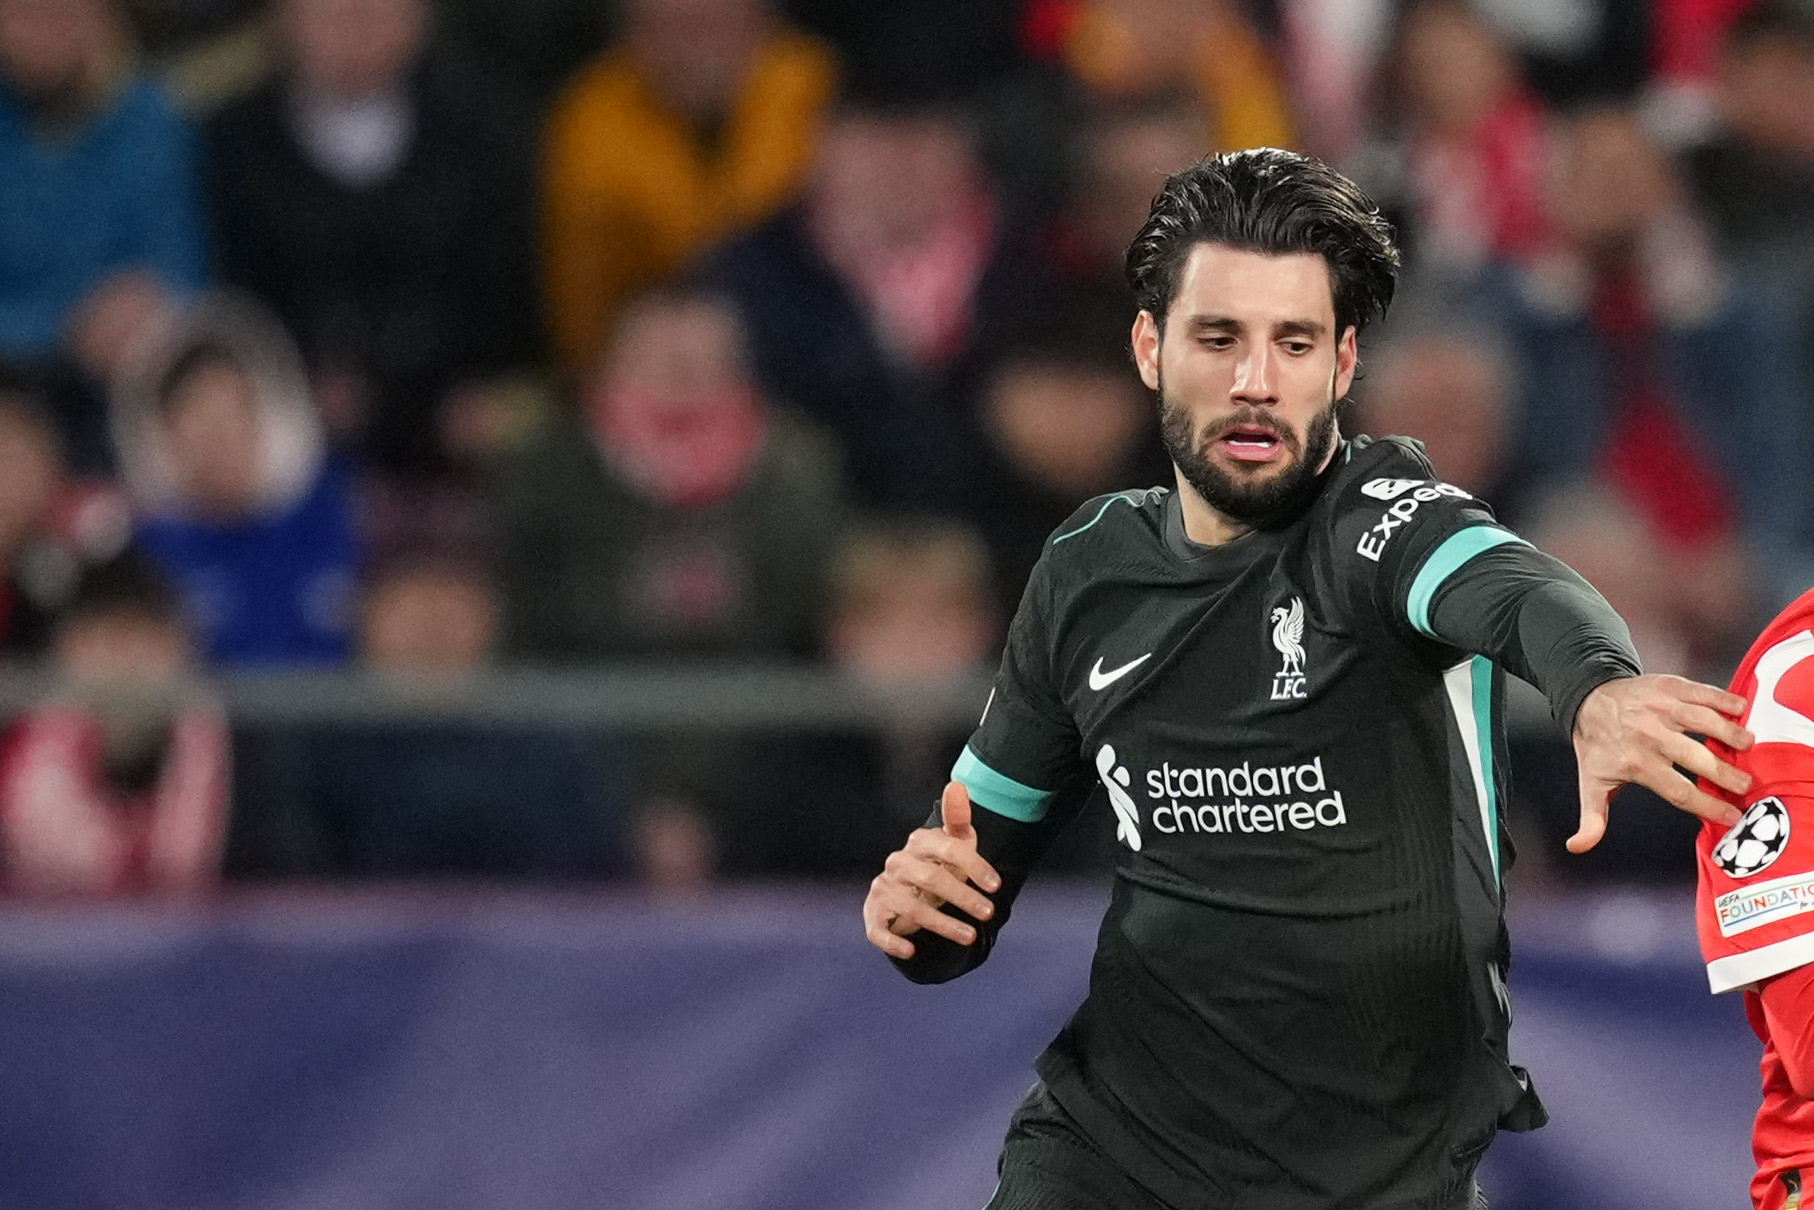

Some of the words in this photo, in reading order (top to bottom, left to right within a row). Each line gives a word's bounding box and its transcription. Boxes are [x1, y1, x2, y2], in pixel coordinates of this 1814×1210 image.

[1146, 755, 1327, 799] standard
[1152, 790, 1347, 834] chartered
[1718, 893, 1741, 908] UEFA
